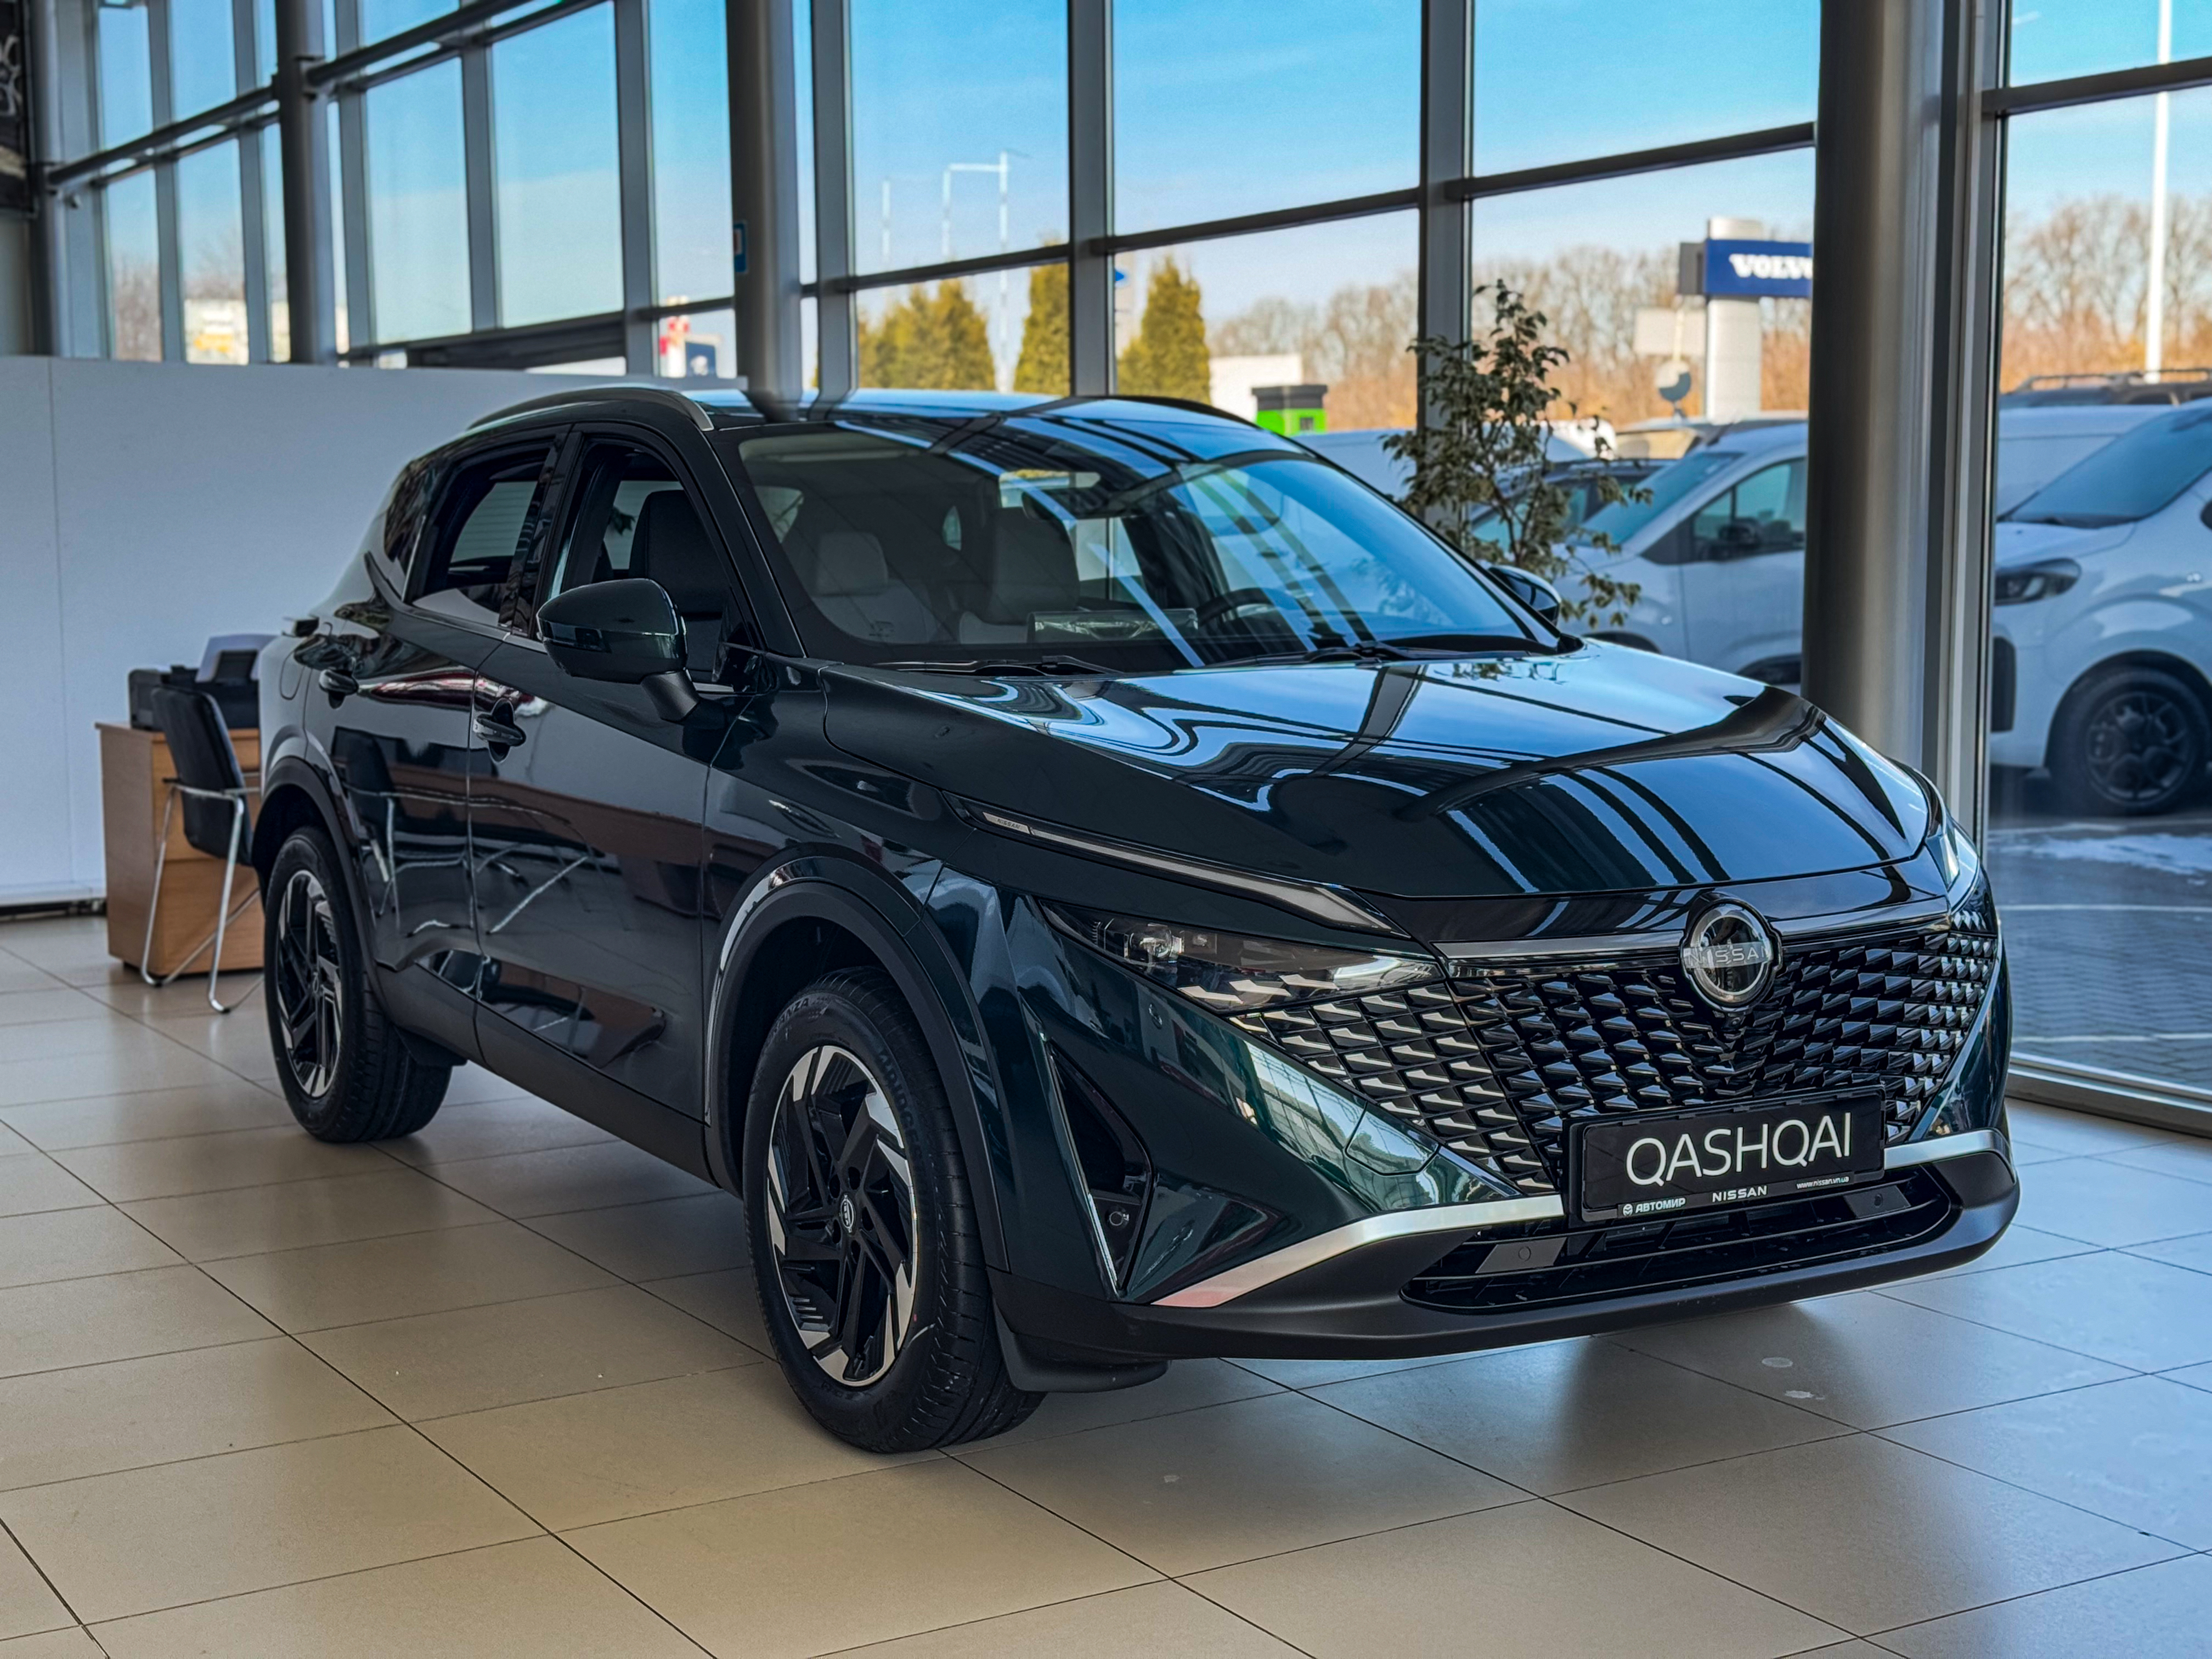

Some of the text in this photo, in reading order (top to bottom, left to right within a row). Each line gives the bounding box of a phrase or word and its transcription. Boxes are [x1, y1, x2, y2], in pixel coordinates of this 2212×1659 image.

[1626, 1112, 1851, 1187] QASHQAI
[1712, 1185, 1768, 1203] NISSAN
[1635, 1198, 1686, 1214] АВТОМИР
